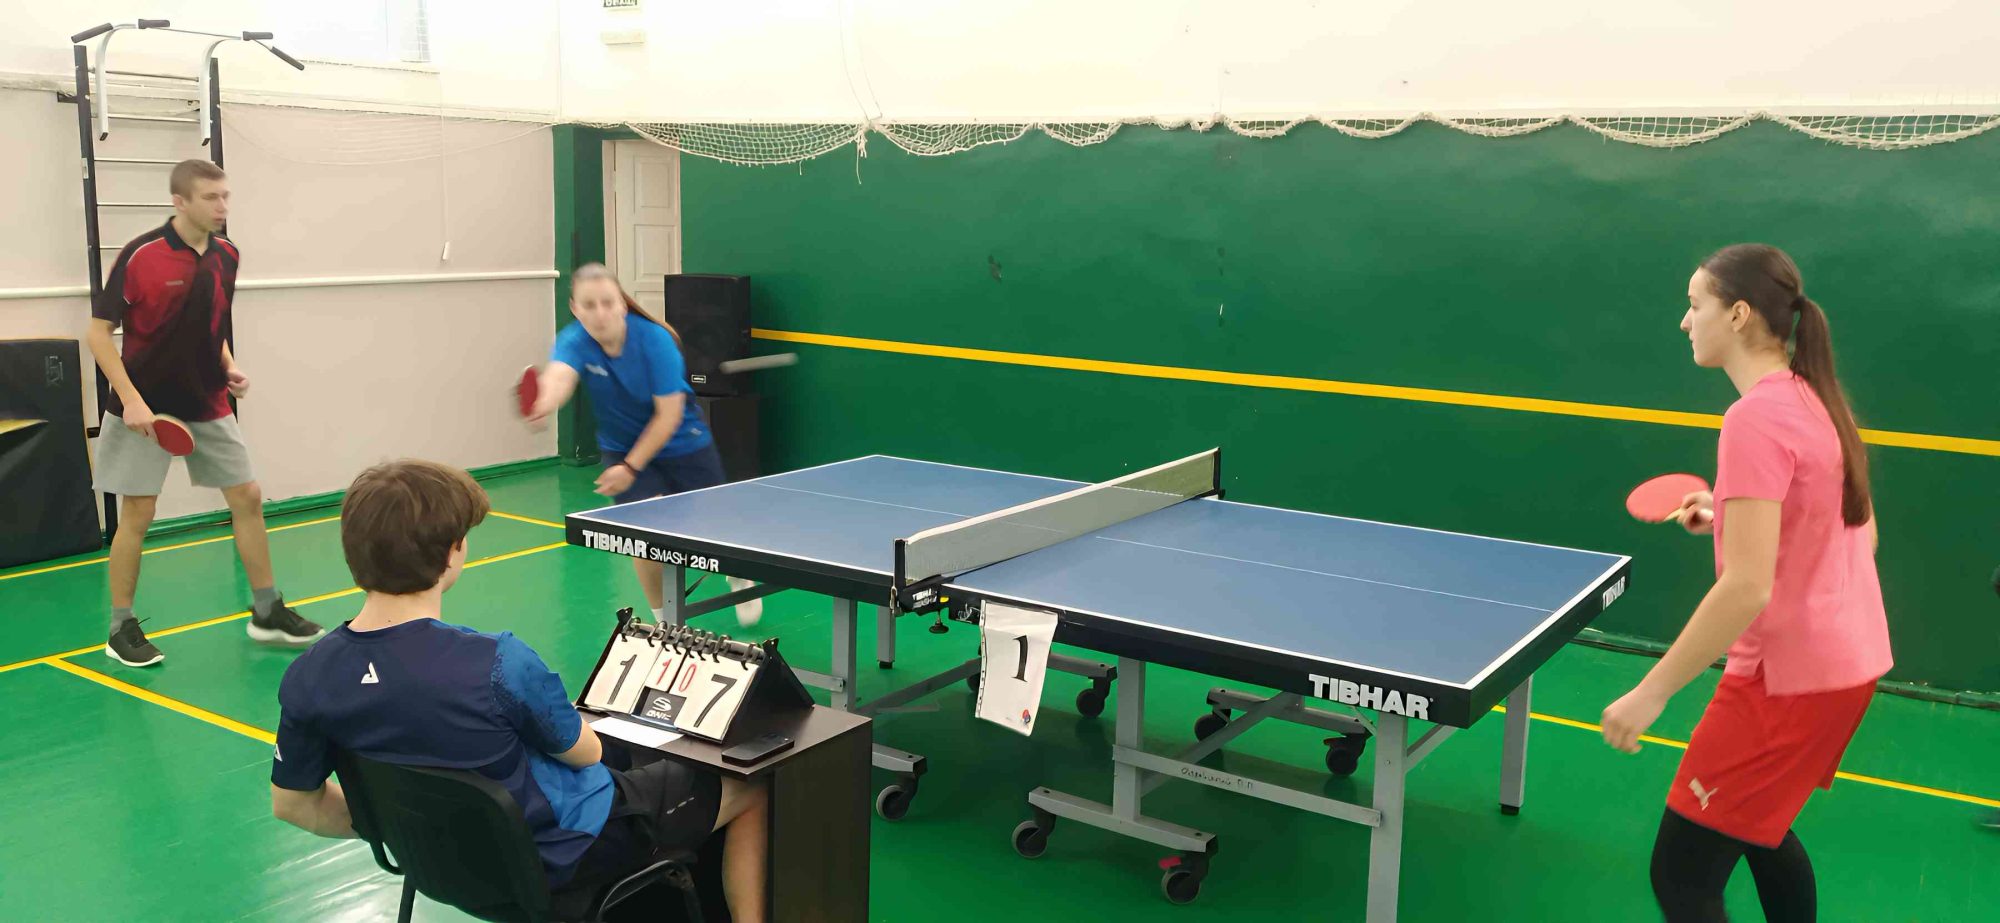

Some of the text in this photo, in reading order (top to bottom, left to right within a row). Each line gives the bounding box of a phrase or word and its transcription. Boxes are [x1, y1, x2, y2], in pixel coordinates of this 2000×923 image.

[582, 530, 719, 572] TIBHAR SMASH 28/R
[1011, 634, 1028, 683] 1
[607, 654, 738, 729] 1 1 0 7
[1308, 673, 1430, 721] TIBHAR
